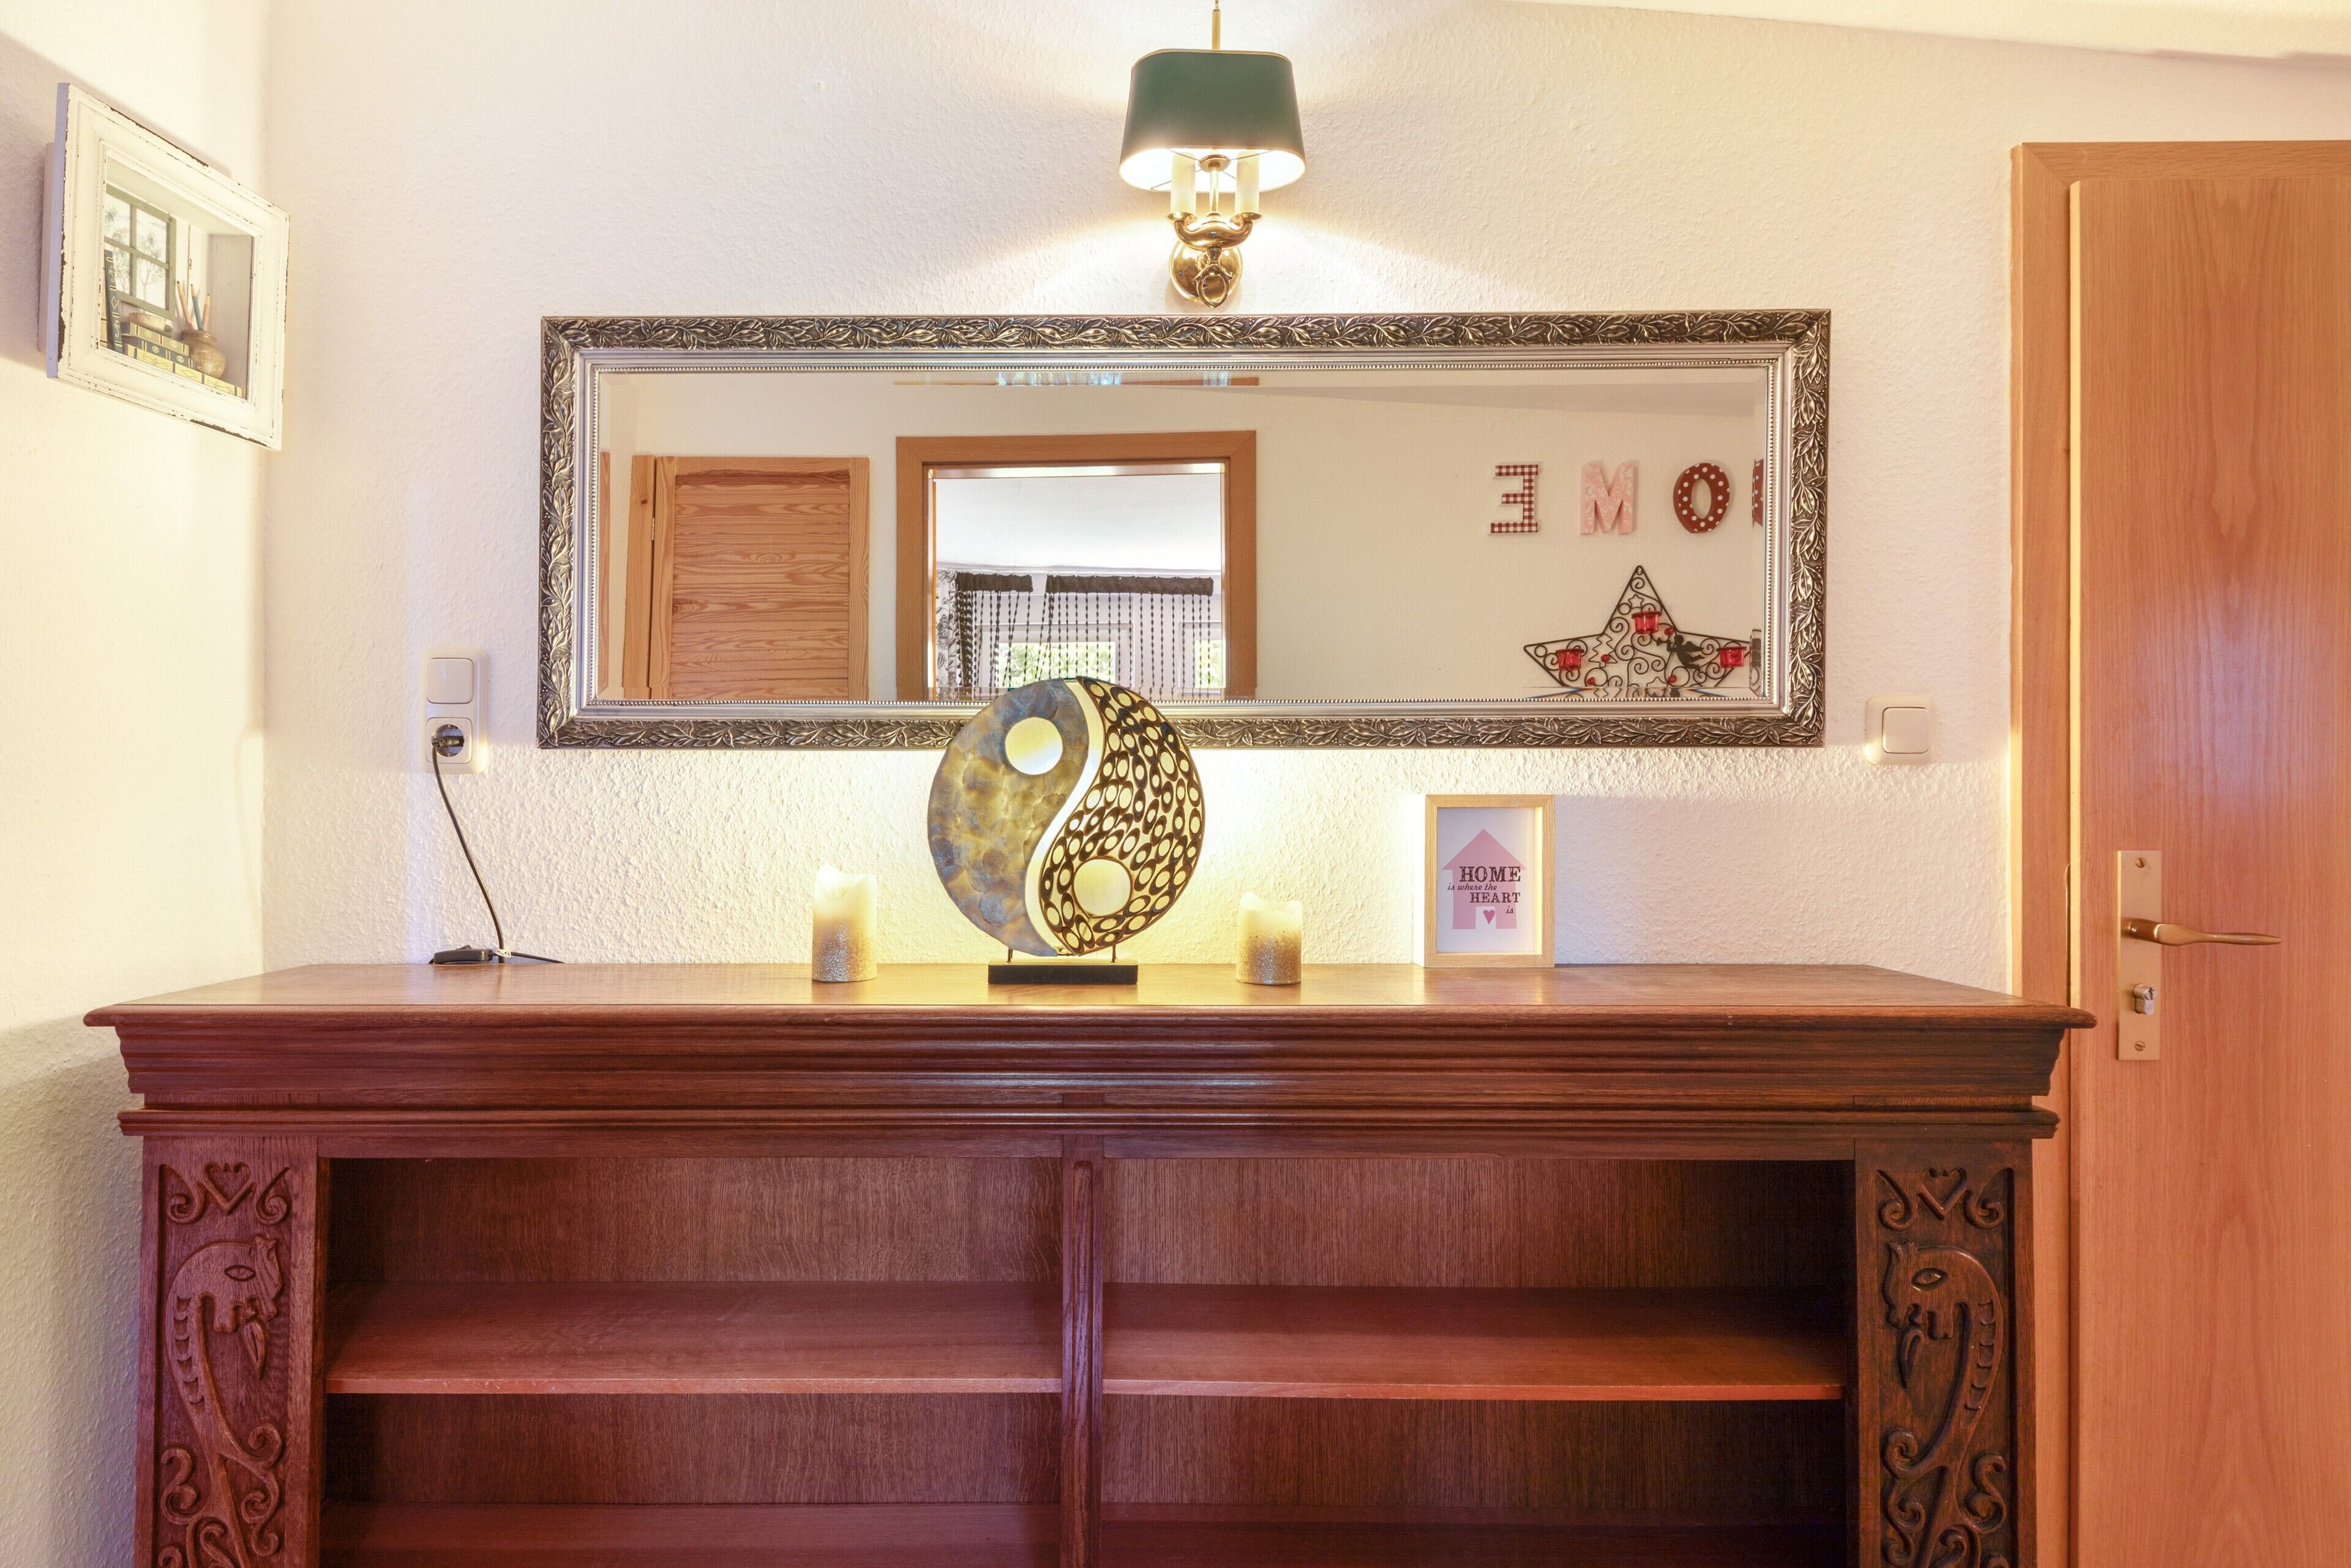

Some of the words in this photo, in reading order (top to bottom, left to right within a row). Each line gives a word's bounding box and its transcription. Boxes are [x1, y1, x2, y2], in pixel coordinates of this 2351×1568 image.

[1459, 866, 1521, 882] HOME
[1469, 892, 1521, 903] HEART
[1505, 906, 1514, 914] is
